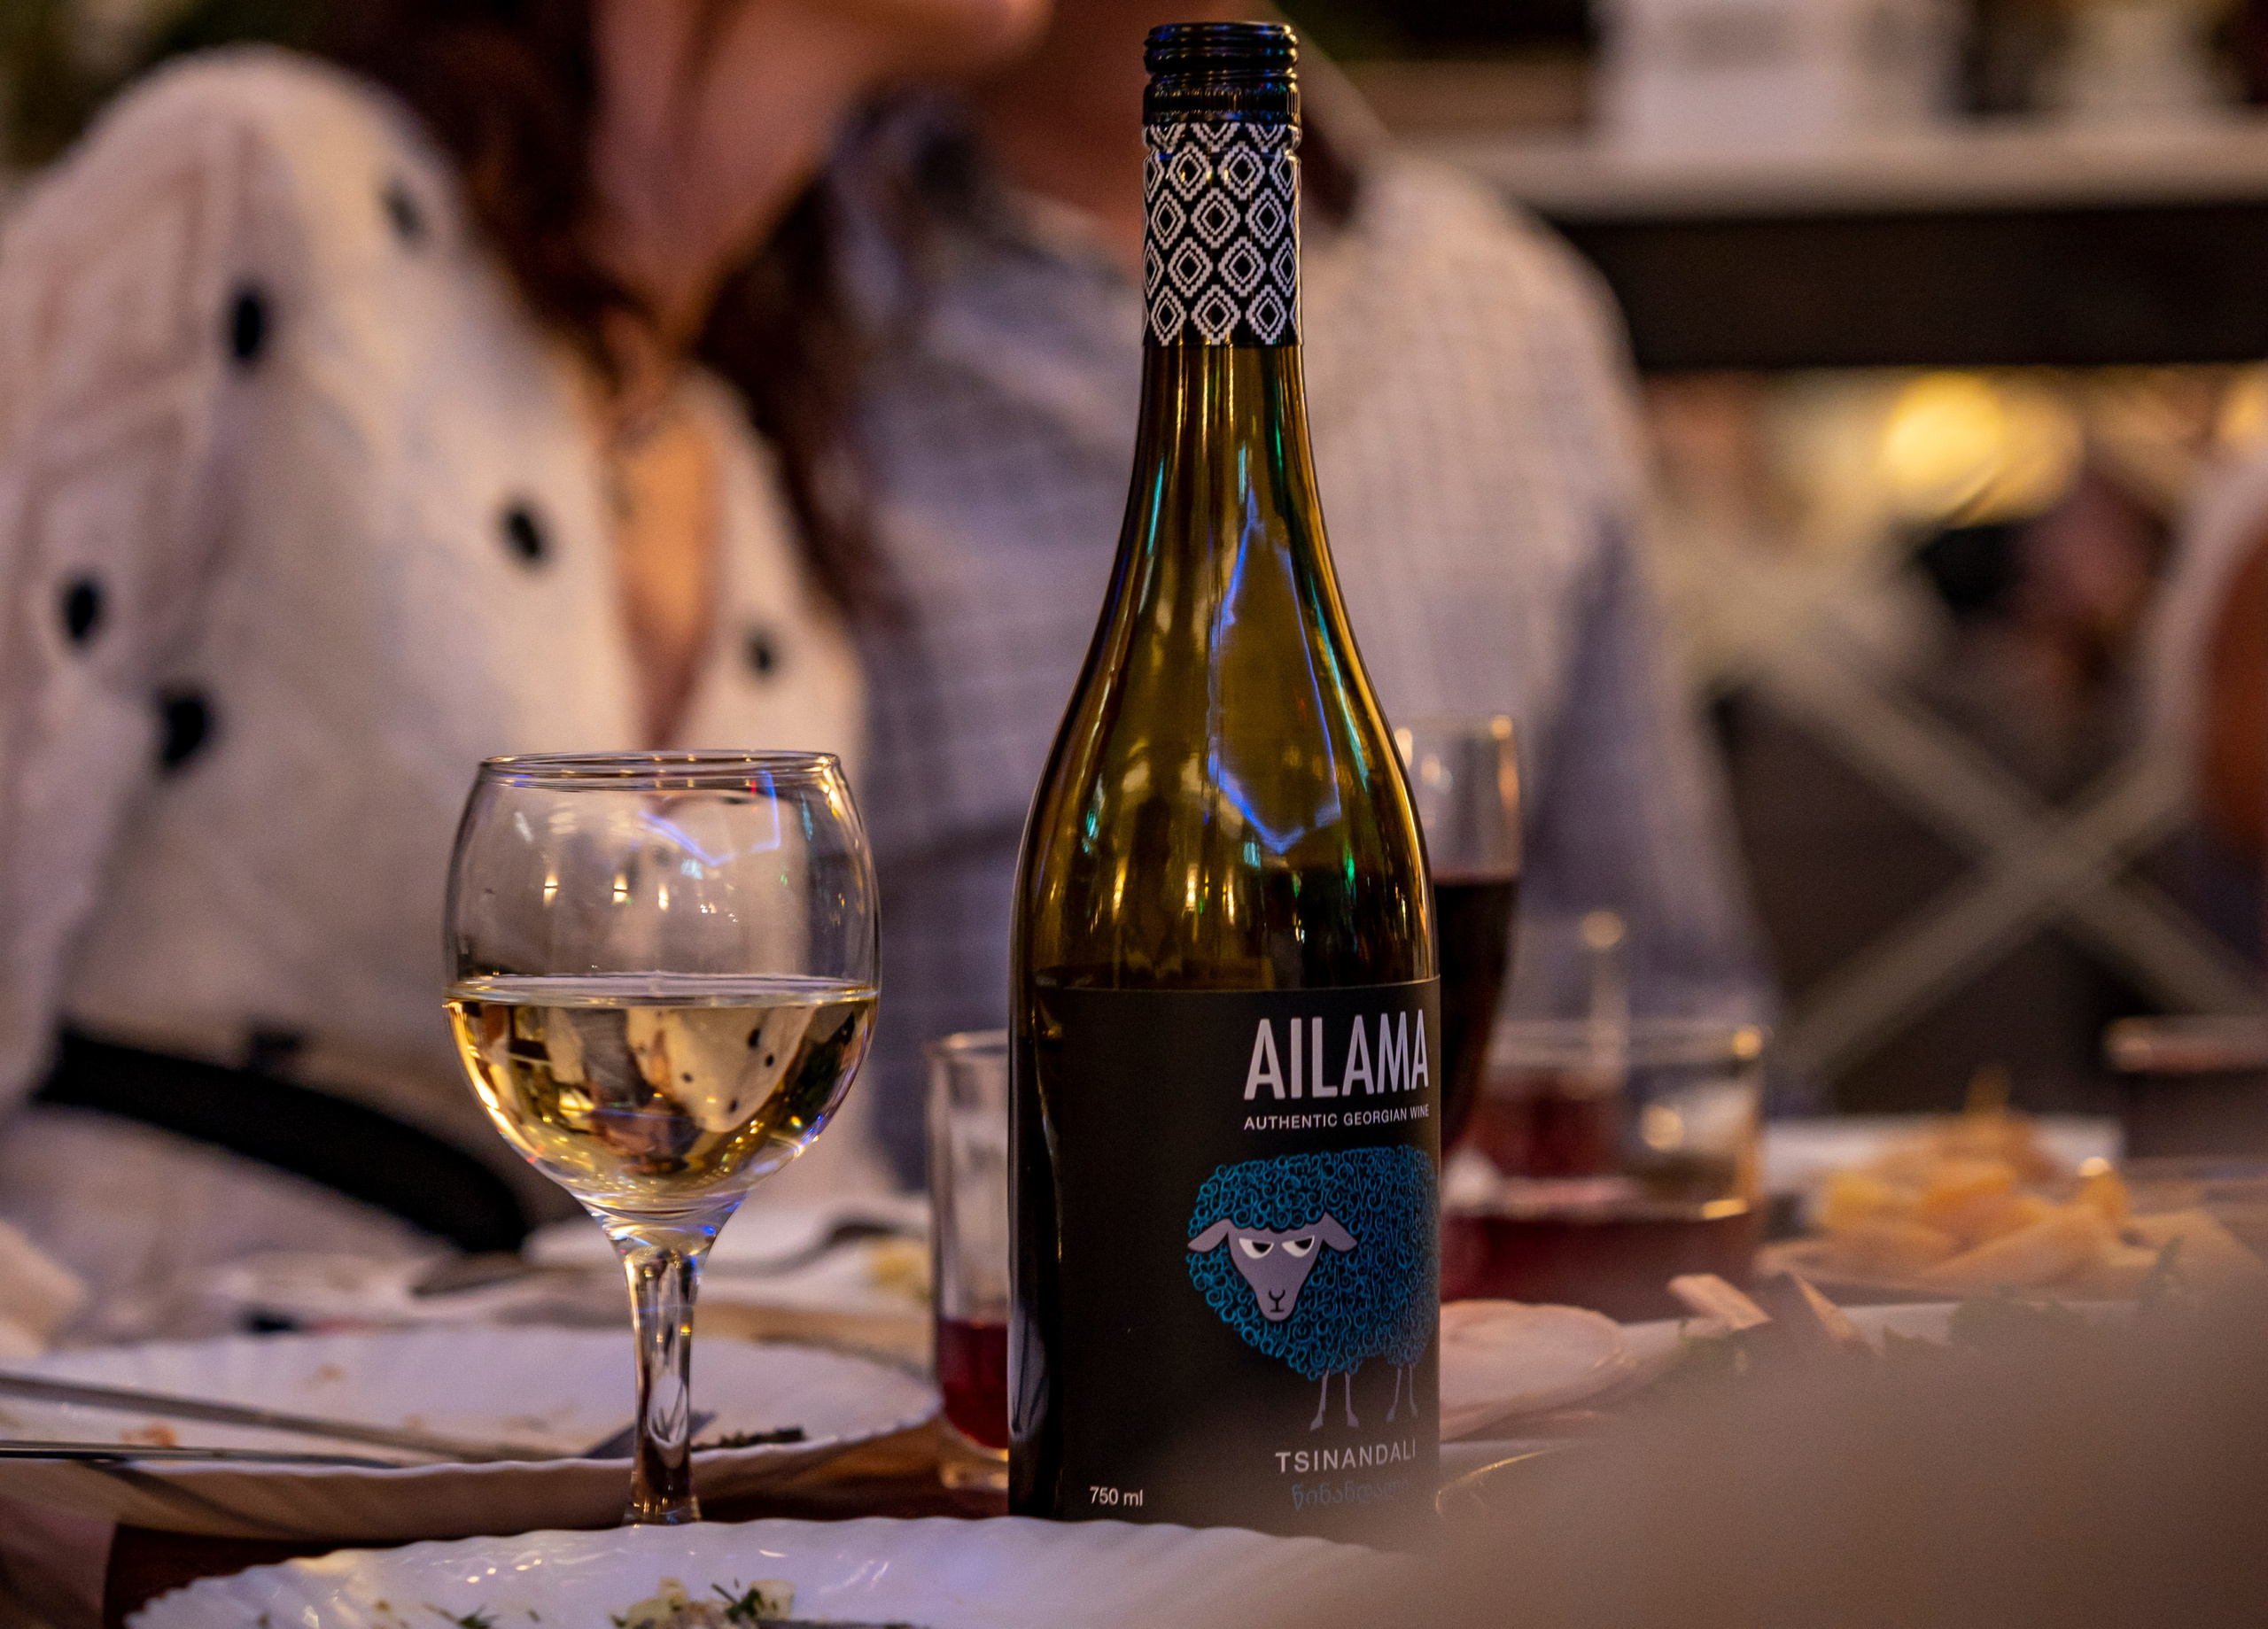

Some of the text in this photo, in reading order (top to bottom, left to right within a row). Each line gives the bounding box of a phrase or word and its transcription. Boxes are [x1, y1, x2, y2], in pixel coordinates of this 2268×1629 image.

[1243, 1009, 1429, 1100] AILAMA
[1243, 1103, 1429, 1130] AUTHENTIC GEORGIAN WINE
[1275, 1437, 1416, 1474] TSINANDALI
[1090, 1485, 1144, 1507] 750 ml
